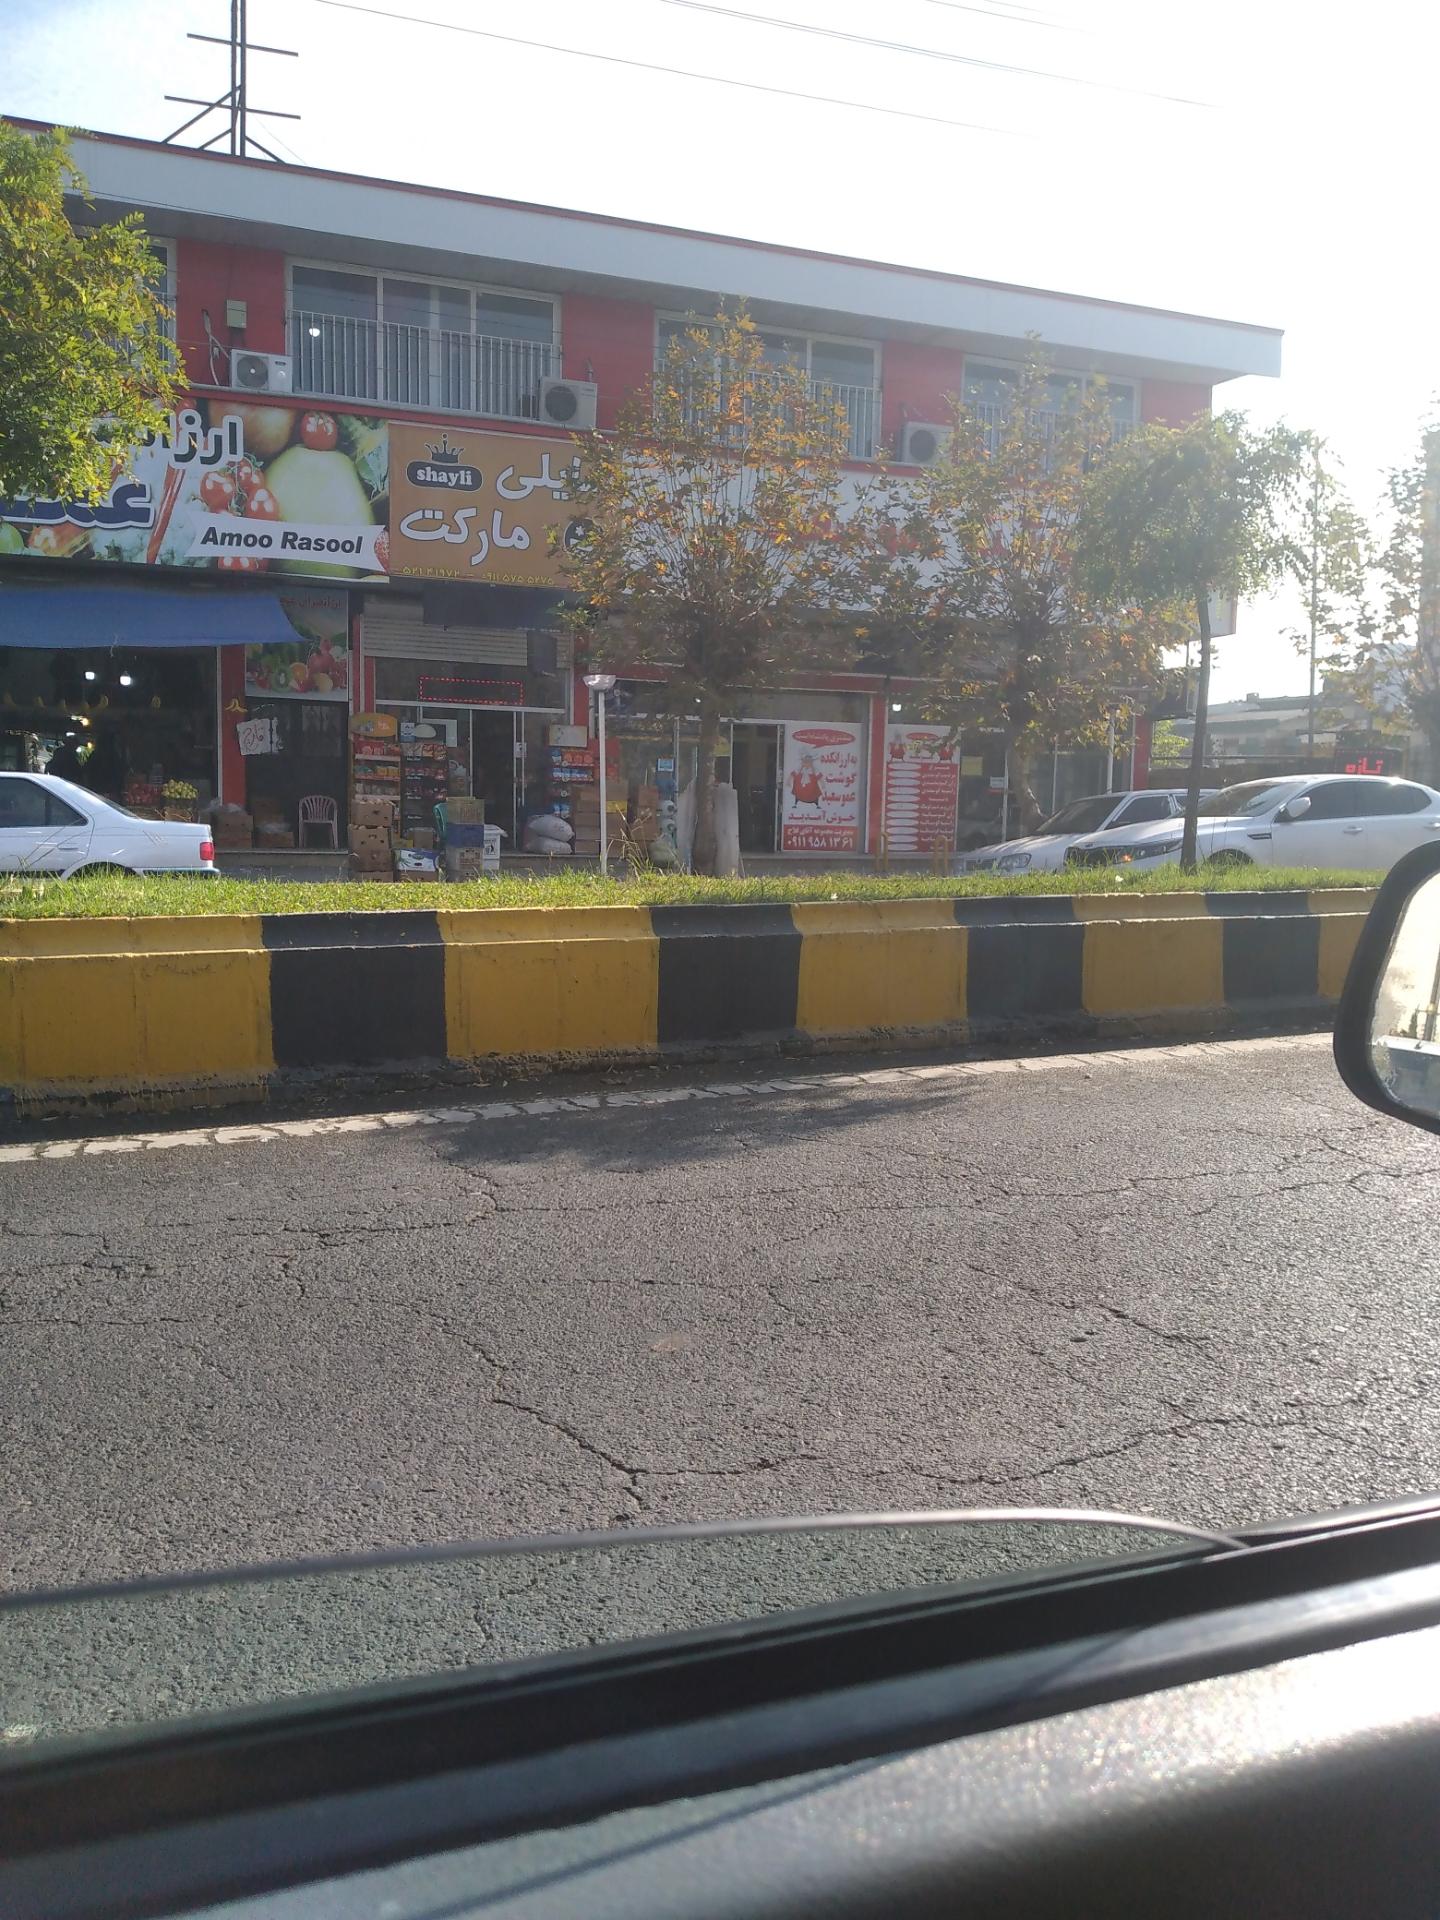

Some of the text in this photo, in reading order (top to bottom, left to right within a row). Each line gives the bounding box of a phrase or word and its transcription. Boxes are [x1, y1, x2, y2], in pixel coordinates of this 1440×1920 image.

[416, 465, 473, 487] shayli
[200, 527, 363, 555] Amoo Rasool
[400, 507, 531, 566] مارکت
[1345, 757, 1384, 775] تازه
[825, 772, 857, 787] گوشت
[826, 812, 856, 824] خوش
